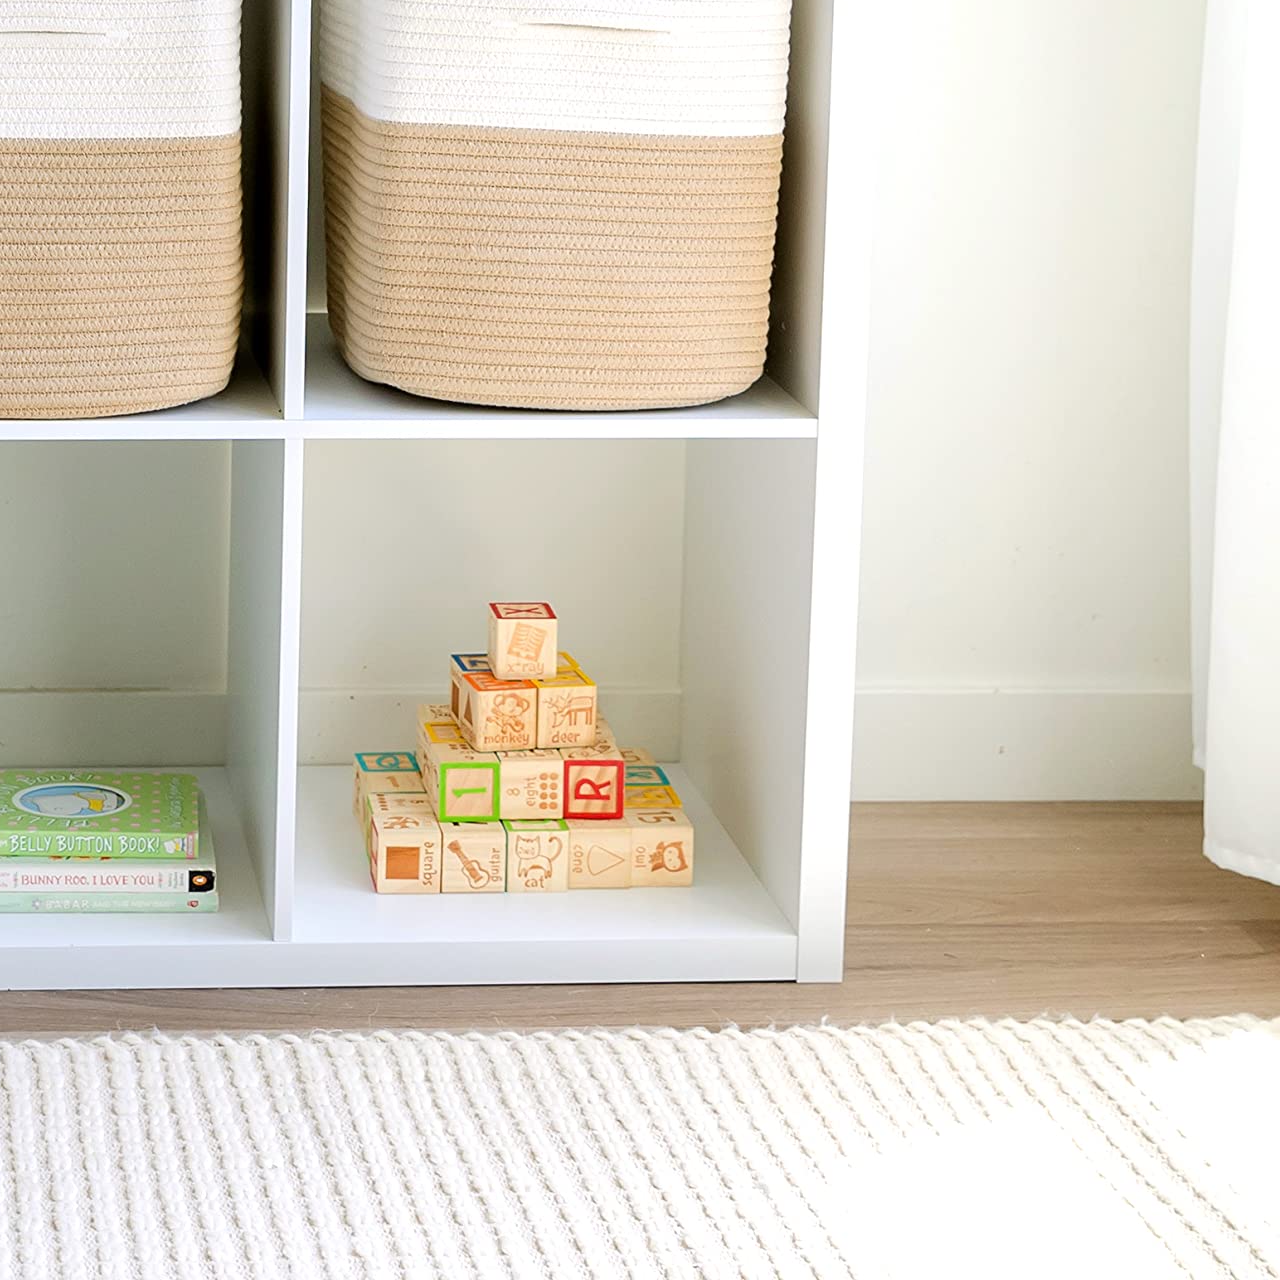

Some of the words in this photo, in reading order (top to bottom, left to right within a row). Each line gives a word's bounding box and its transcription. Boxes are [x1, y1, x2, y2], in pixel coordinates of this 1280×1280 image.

[503, 607, 543, 616] X
[484, 731, 529, 746] monkey
[552, 731, 581, 743] deer
[507, 788, 520, 796] 8
[524, 776, 538, 807] eight
[575, 778, 611, 801] R
[9, 834, 51, 852] BELLY
[56, 835, 113, 853] BUTTON
[118, 835, 160, 853] BOOK!
[423, 841, 437, 886] square
[490, 847, 502, 882] guitar
[635, 846, 646, 868] owl
[21, 874, 60, 885] BUNNY
[93, 875, 97, 885] I
[100, 875, 129, 885] LOVE
[131, 875, 154, 885] YOU
[525, 877, 545, 888] cat
